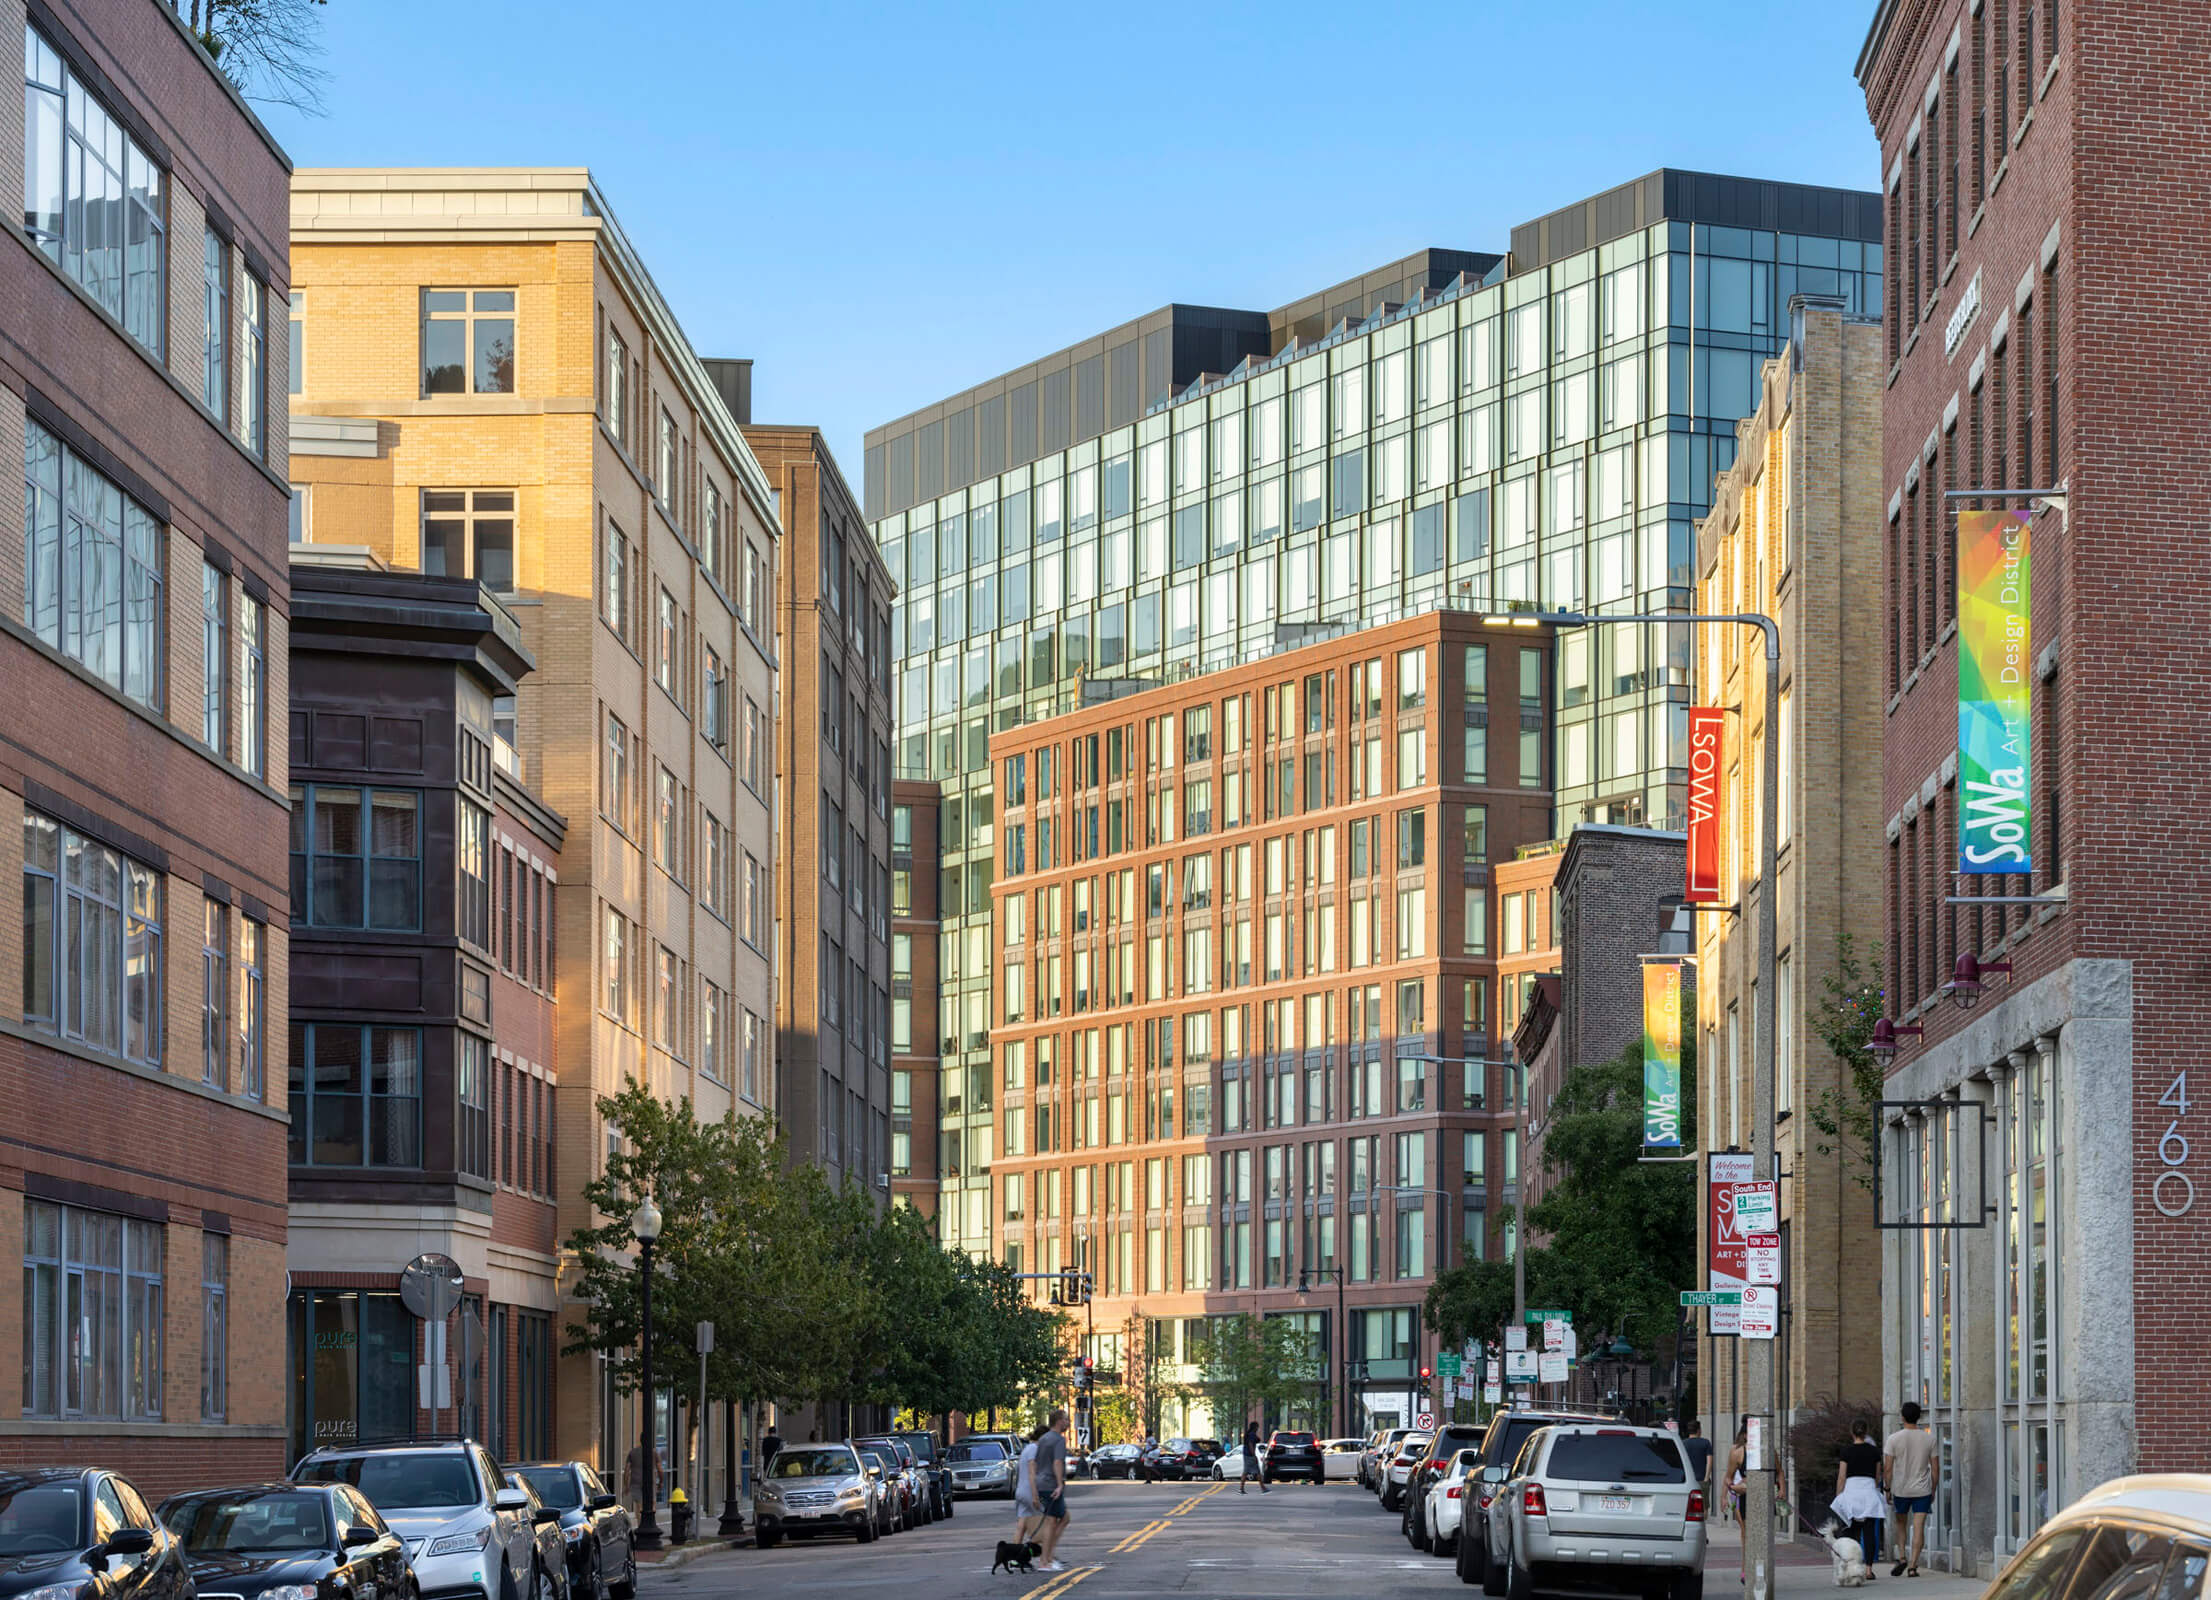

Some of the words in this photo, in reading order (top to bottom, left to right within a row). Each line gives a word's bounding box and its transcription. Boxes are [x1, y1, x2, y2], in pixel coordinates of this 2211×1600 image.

[2000, 525, 2019, 604] District
[2000, 614, 2024, 683] Design
[2000, 719, 2019, 755] Art
[1965, 766, 2024, 864] SoWa
[1664, 971, 1675, 1012] District
[1665, 1068, 1674, 1088] Art
[1647, 1093, 1677, 1143] SoWa
[1715, 1160, 1752, 1171] Welcome
[1715, 1171, 1723, 1179] to
[1725, 1170, 1738, 1179] the
[1734, 1185, 1755, 1193] South
[1758, 1183, 1772, 1191] End
[1749, 1237, 1761, 1246] TOW
[1762, 1237, 1777, 1246] ZONE
[1716, 1251, 1732, 1259] ART
[1688, 1293, 1717, 1304] THAYER
